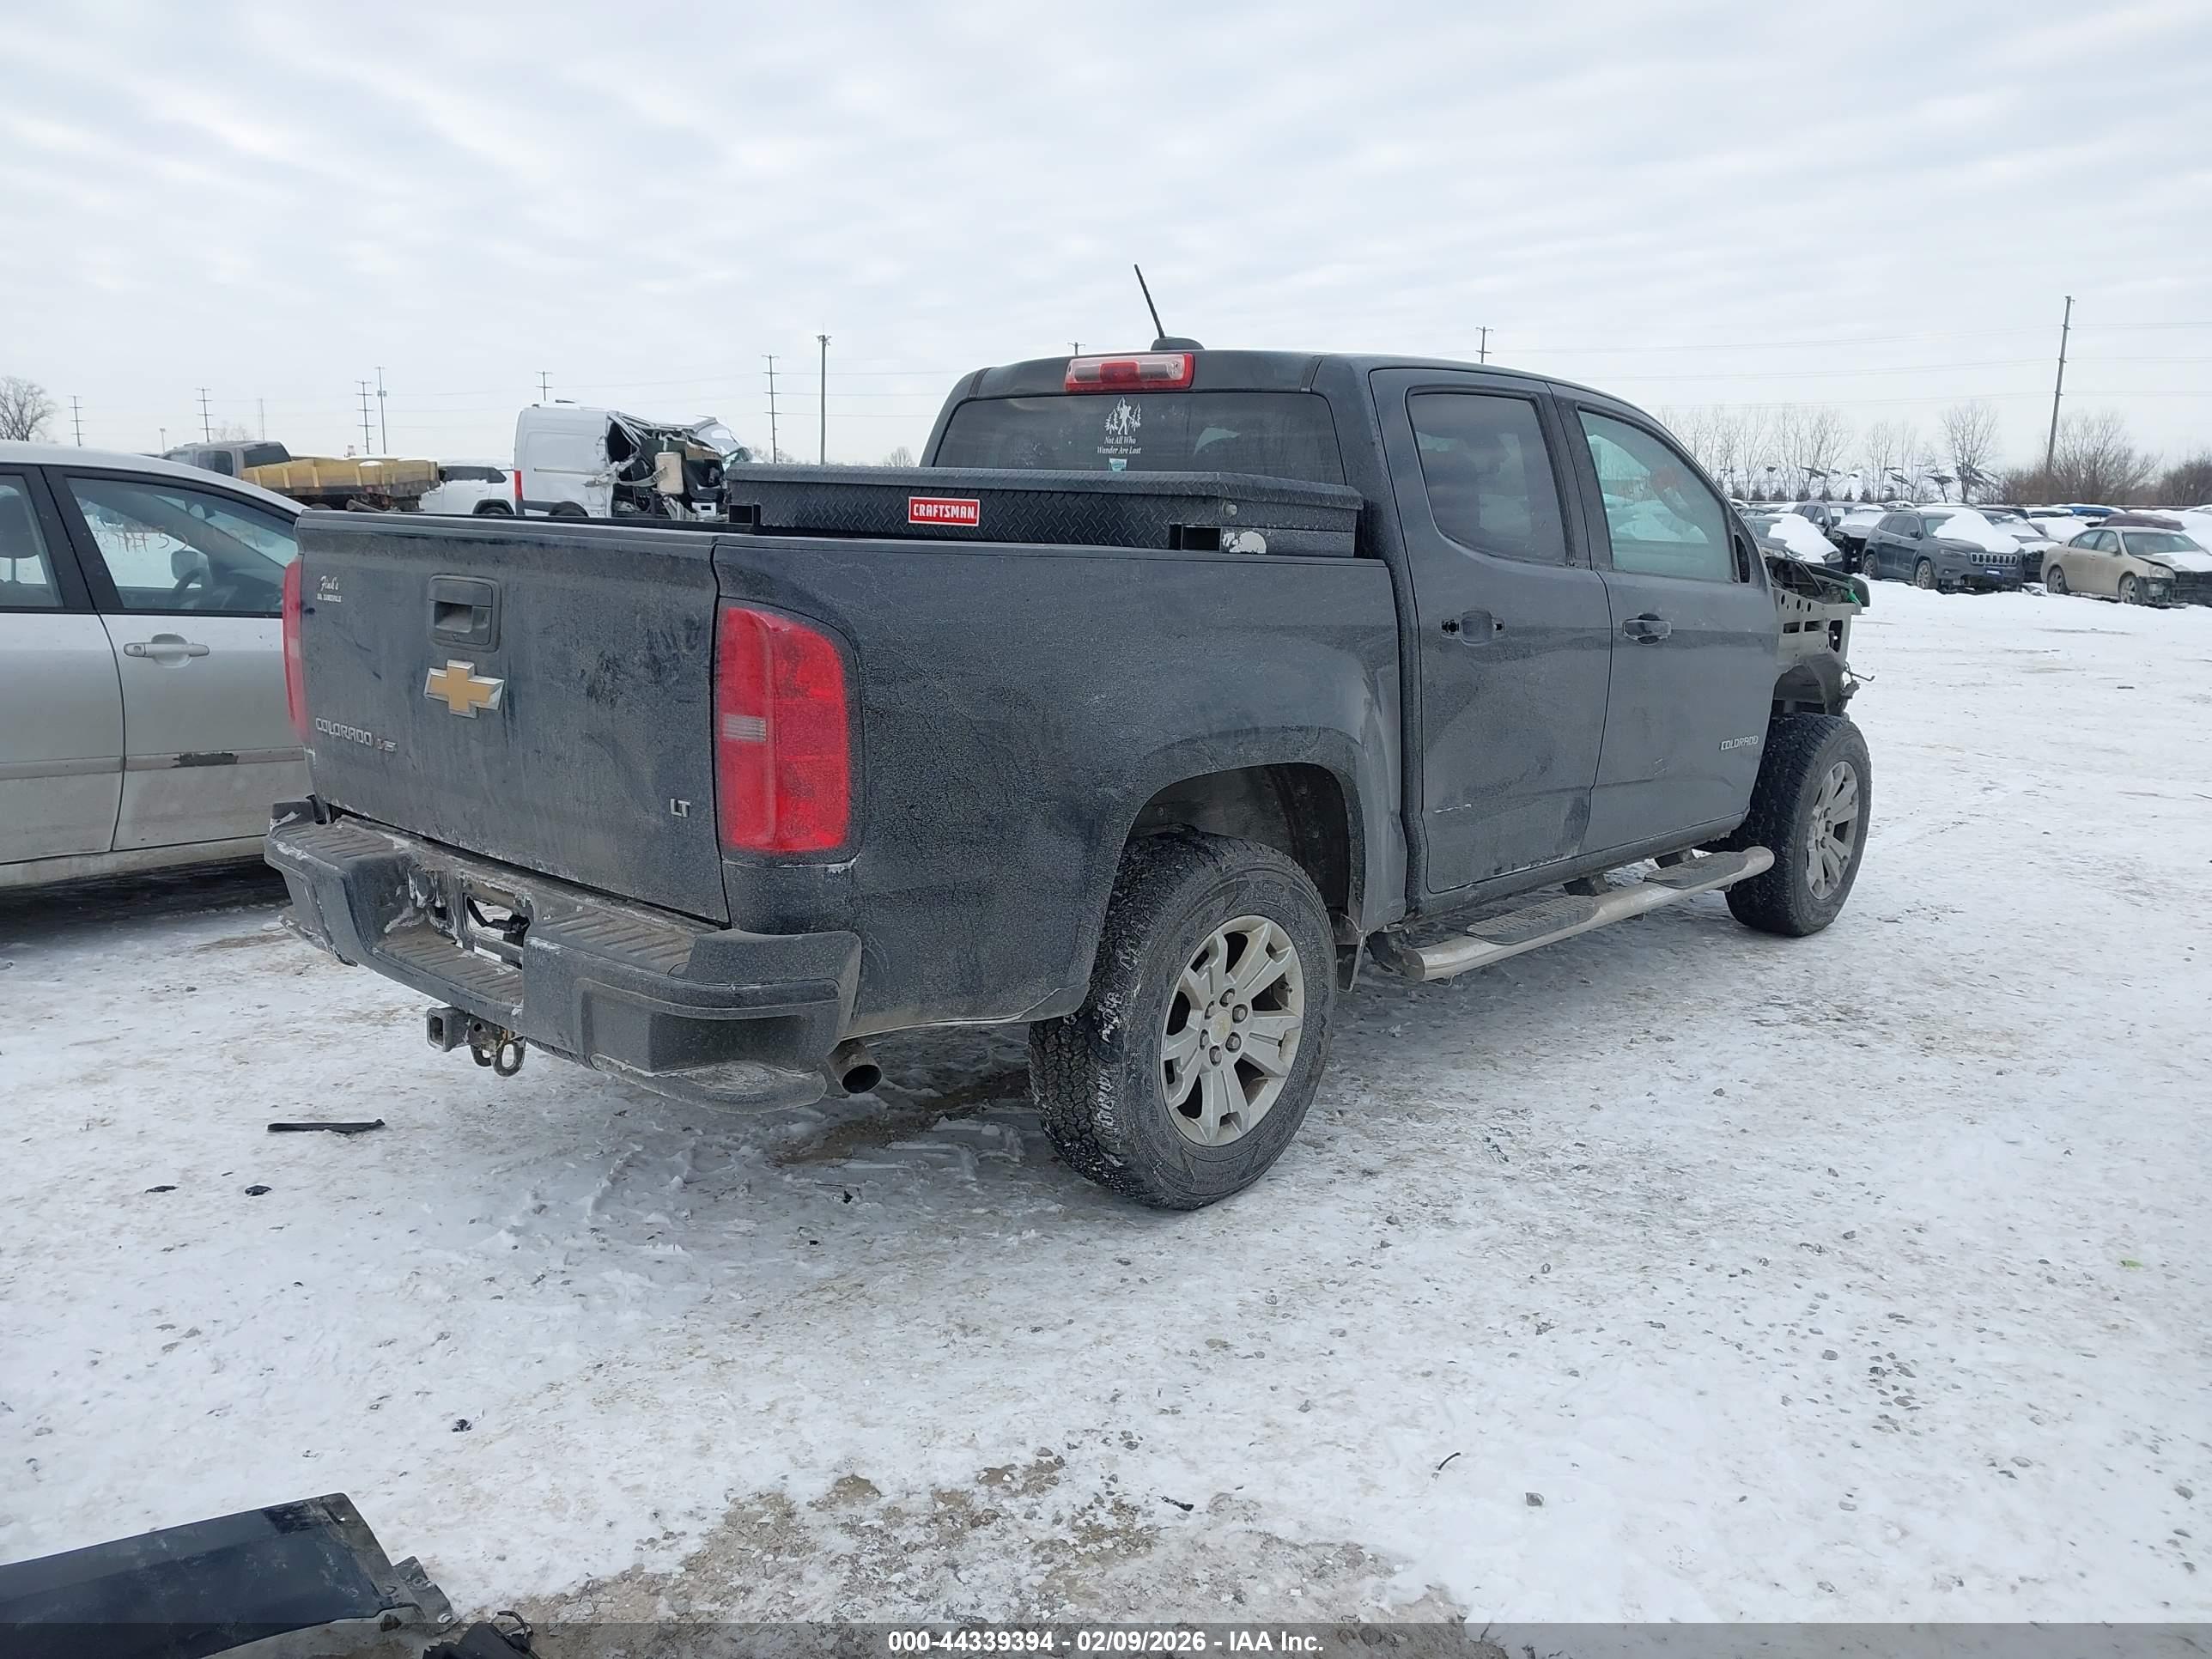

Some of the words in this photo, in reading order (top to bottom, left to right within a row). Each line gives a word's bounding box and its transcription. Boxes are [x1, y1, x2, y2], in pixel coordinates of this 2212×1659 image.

[1103, 435, 1114, 445] Not
[1115, 435, 1123, 445] All
[1123, 435, 1137, 445] Who
[1097, 446, 1118, 454] Wander
[1118, 446, 1129, 454] Are
[1129, 446, 1142, 454] Lost
[913, 502, 975, 520] CRAFTSMAN
[315, 717, 373, 747] COLORADO
[1721, 735, 1759, 750] COLORADO
[670, 798, 690, 817] LT
